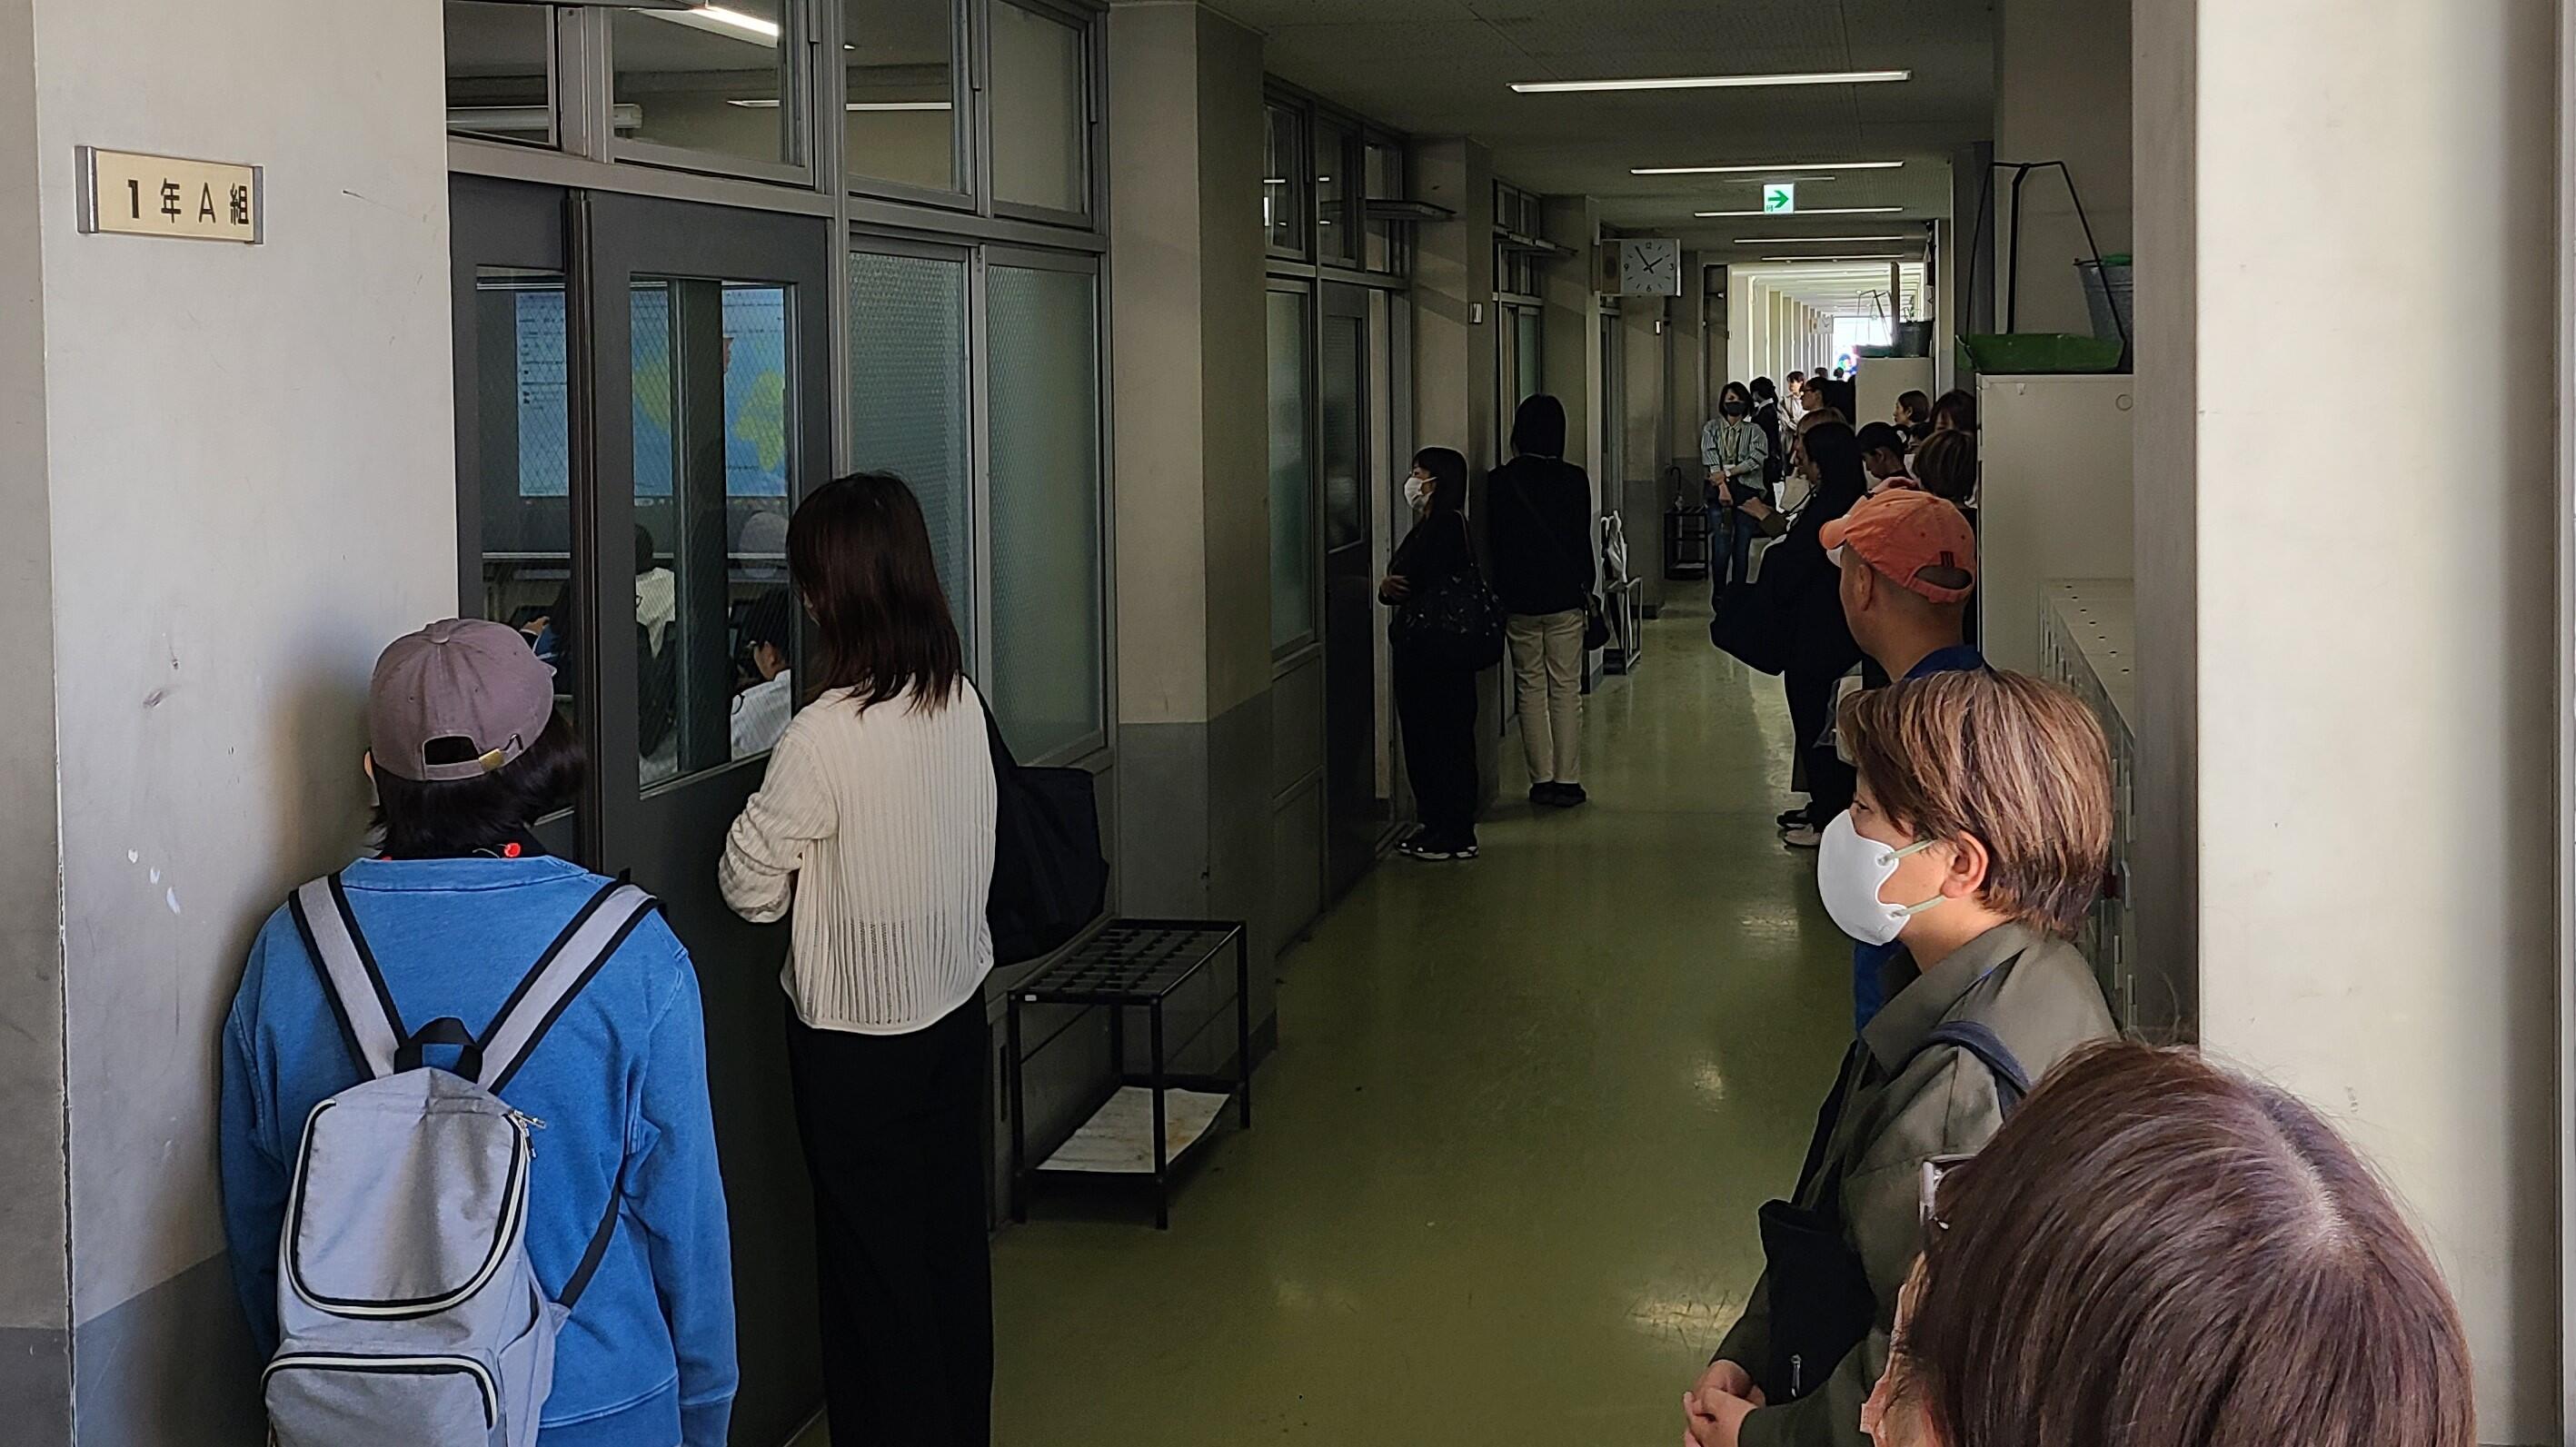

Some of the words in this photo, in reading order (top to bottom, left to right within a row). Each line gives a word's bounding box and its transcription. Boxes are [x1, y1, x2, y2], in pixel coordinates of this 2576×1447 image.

[127, 177, 250, 225] 1年A組
[1646, 242, 1652, 250] 12
[1624, 263, 1629, 272] 9
[1668, 263, 1674, 271] 3
